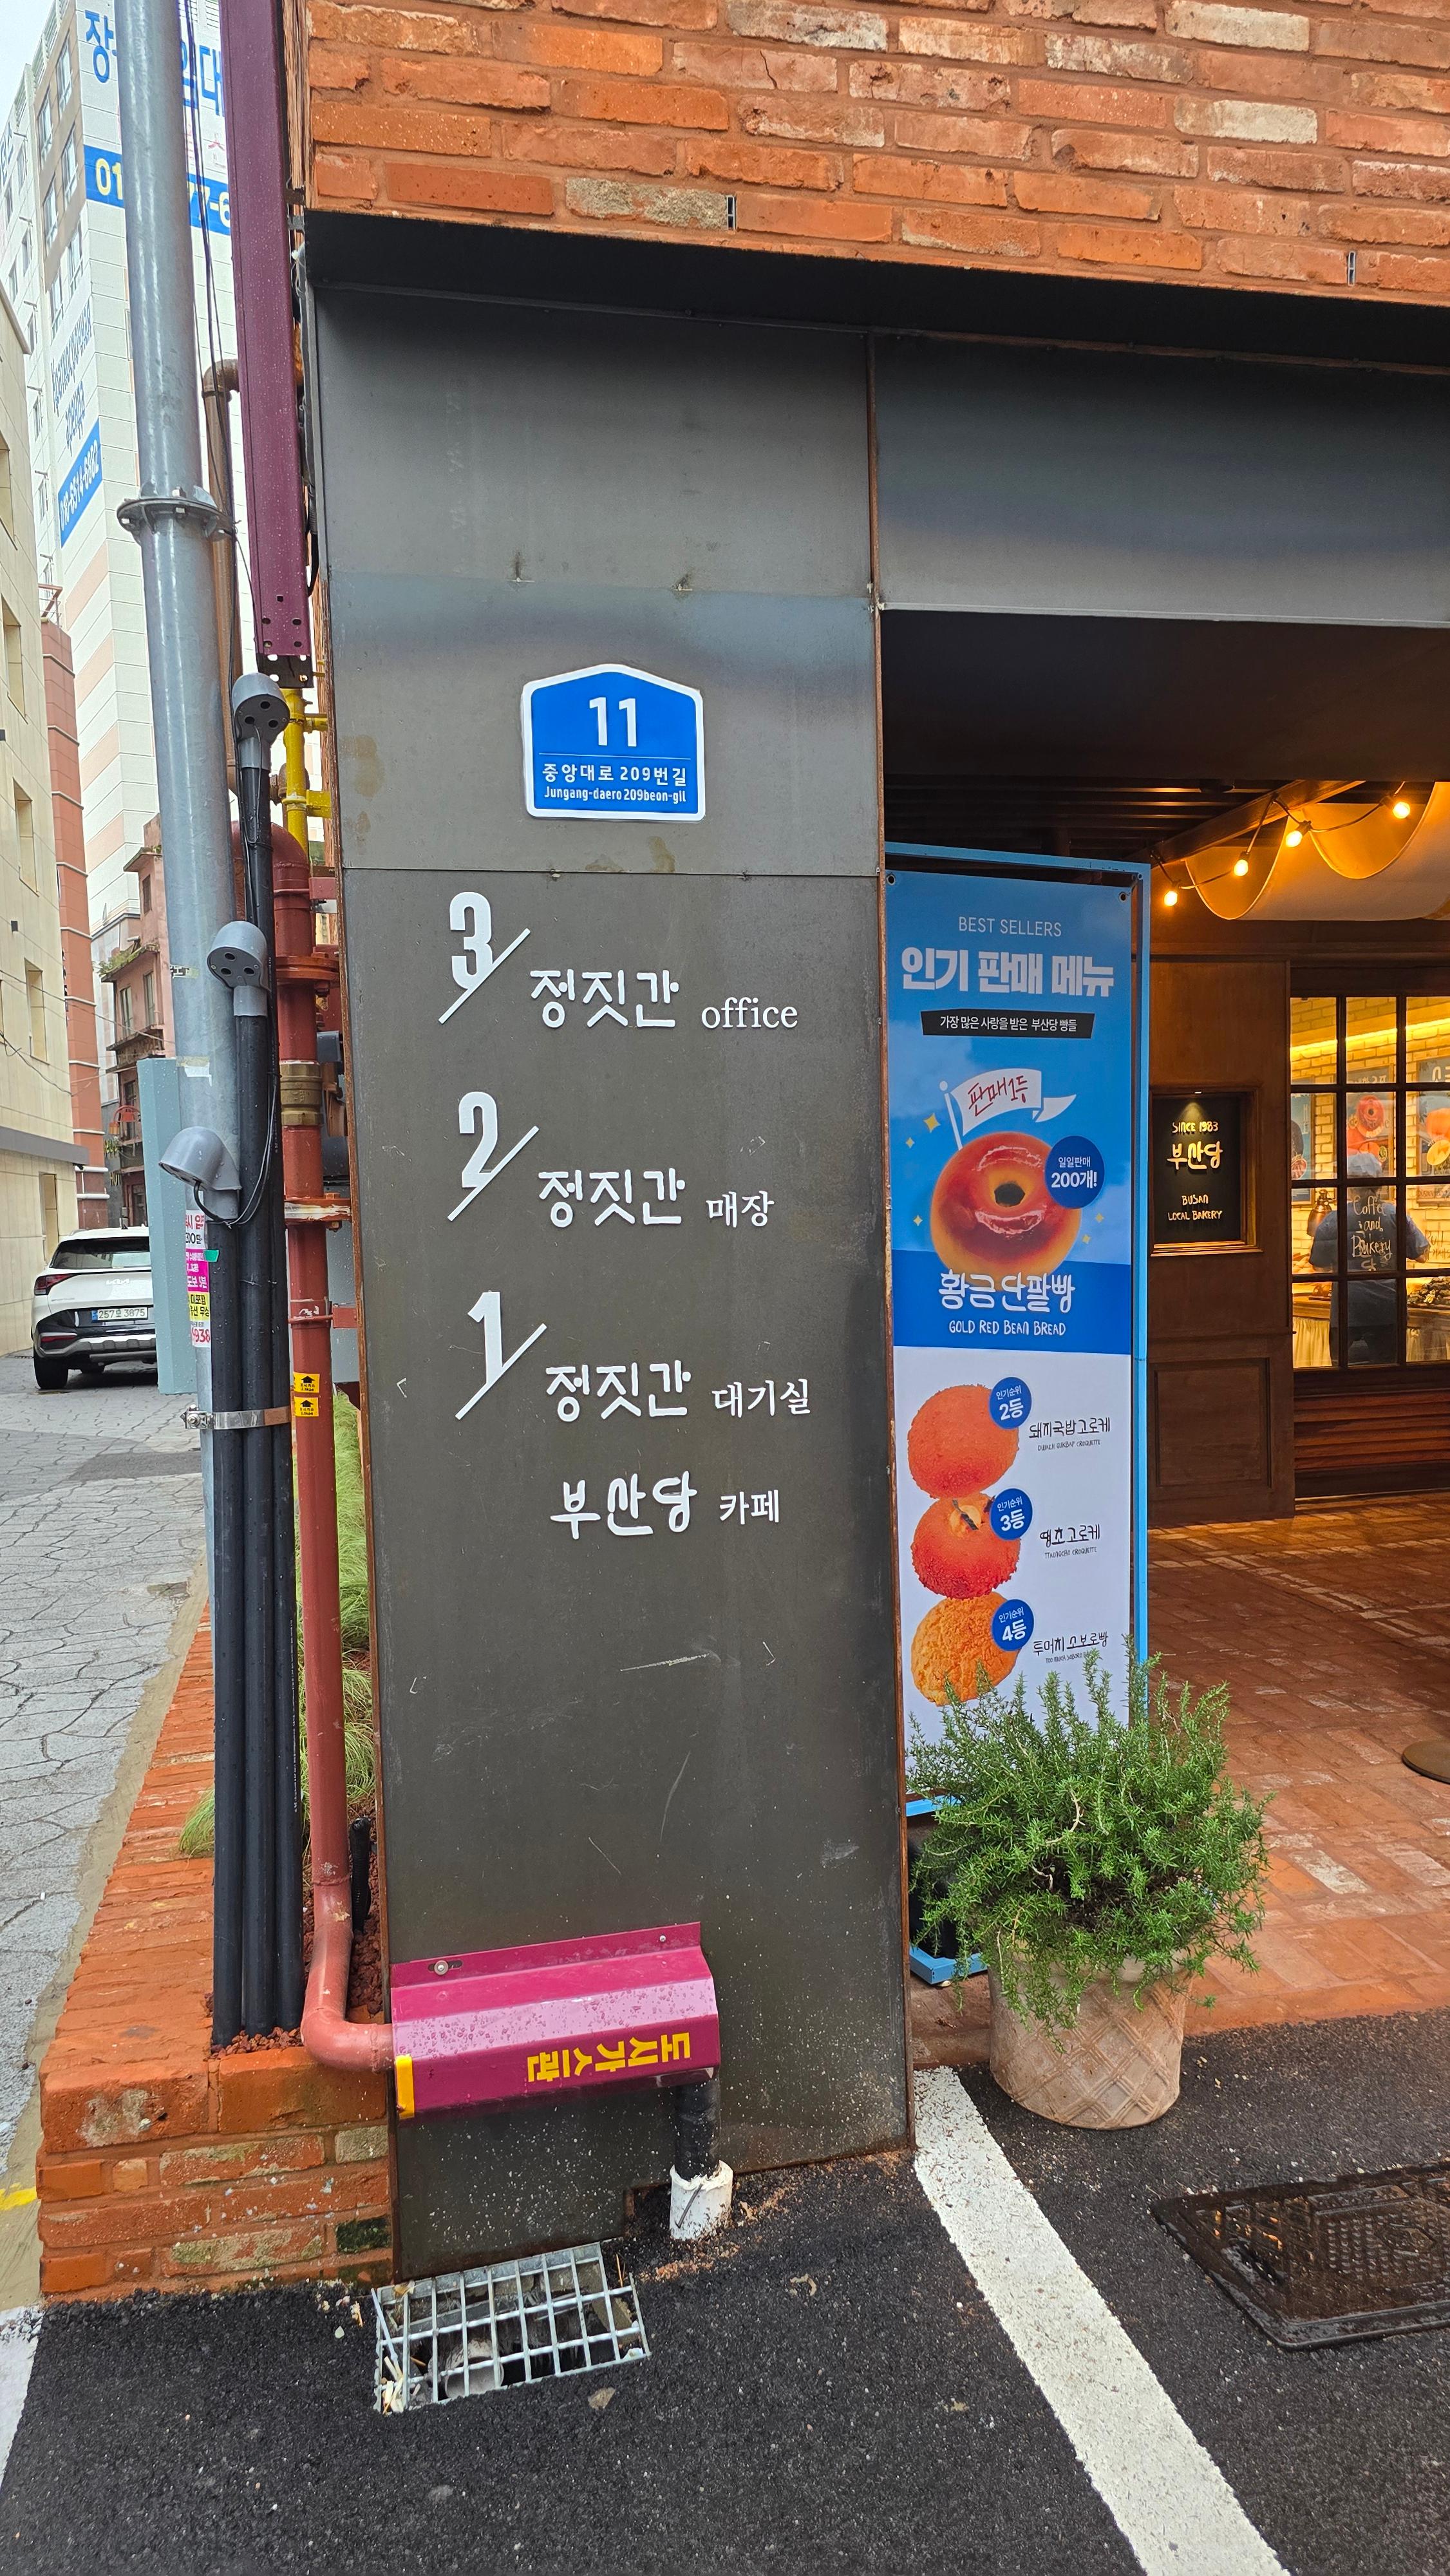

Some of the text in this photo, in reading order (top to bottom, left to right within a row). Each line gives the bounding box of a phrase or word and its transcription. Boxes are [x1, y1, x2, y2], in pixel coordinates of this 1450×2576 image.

[589, 697, 637, 747] 11
[542, 763, 686, 787] 중앙대로 209번길
[544, 786, 686, 804] Jungang-daero 209beon-gil
[959, 916, 1062, 937] BEST SELLERS
[901, 947, 1114, 997] 인기 판매 메뉴
[531, 969, 679, 1028] 정짓간
[701, 998, 798, 1029] office
[940, 1016, 1077, 1032] 가장 많은 사랑을 받은 부산당 빵들
[1172, 1121, 1219, 1133] SINCE 1983
[1058, 1156, 1091, 1168] 일일판매
[1167, 1141, 1223, 1171] 부산당
[1051, 1170, 1097, 1189] 200개!
[538, 1168, 686, 1227] 정짓간
[706, 1191, 775, 1228] 매장
[1182, 1194, 1209, 1206] BUSAN
[1167, 1209, 1223, 1221] LOCAL BAKERY
[949, 1320, 1066, 1336] GOLD RED BEAN BREAD
[546, 1360, 692, 1422] 정짓간
[711, 1378, 811, 1418] 대기실
[996, 1385, 1022, 1400] 인기순위
[999, 1398, 1024, 1420] 2등
[550, 1470, 780, 1540] 부산당 카페
[997, 1496, 1023, 1512] 인기순위
[1000, 1509, 1025, 1531] 3등
[999, 1606, 1024, 1624] 인기순위
[1002, 1618, 1027, 1642] 4등
[527, 2032, 691, 2083] 도시가스관
